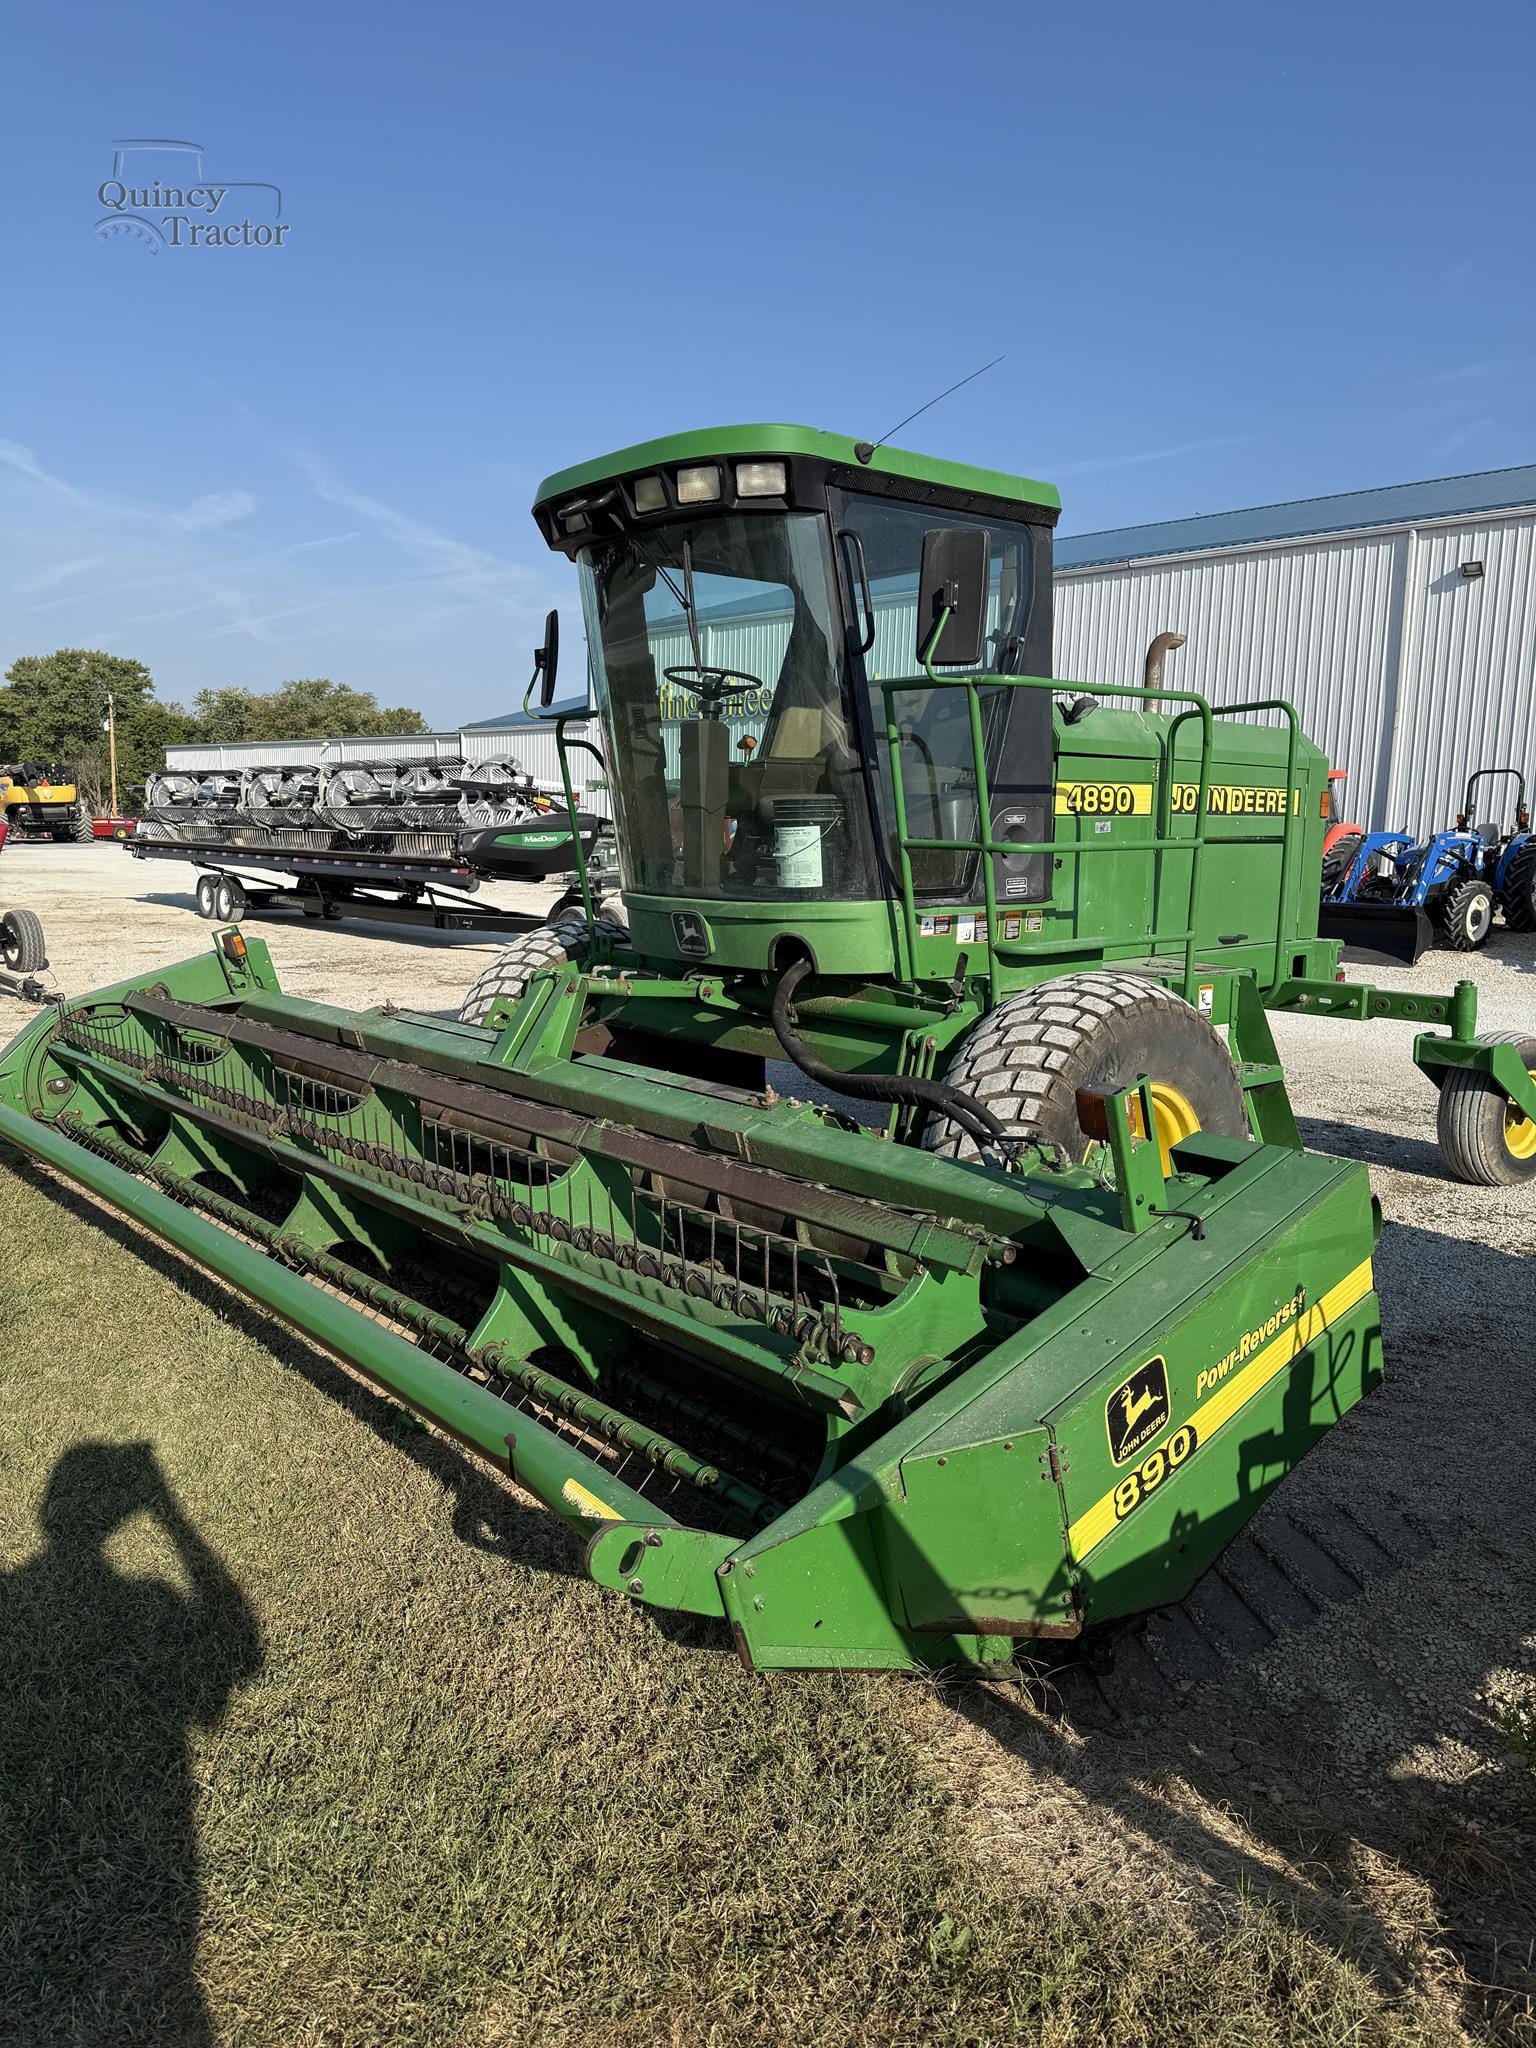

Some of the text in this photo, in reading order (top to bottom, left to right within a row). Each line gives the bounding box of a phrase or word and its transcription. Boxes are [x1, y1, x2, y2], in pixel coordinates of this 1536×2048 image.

[1067, 785, 1135, 815] 4890
[1171, 786, 1287, 815] JON DEERE
[524, 835, 558, 843] MacDon
[1196, 1288, 1307, 1400] Powr-Reverser
[1117, 1411, 1167, 1461] JOHN DEERE
[1114, 1425, 1198, 1520] 890
